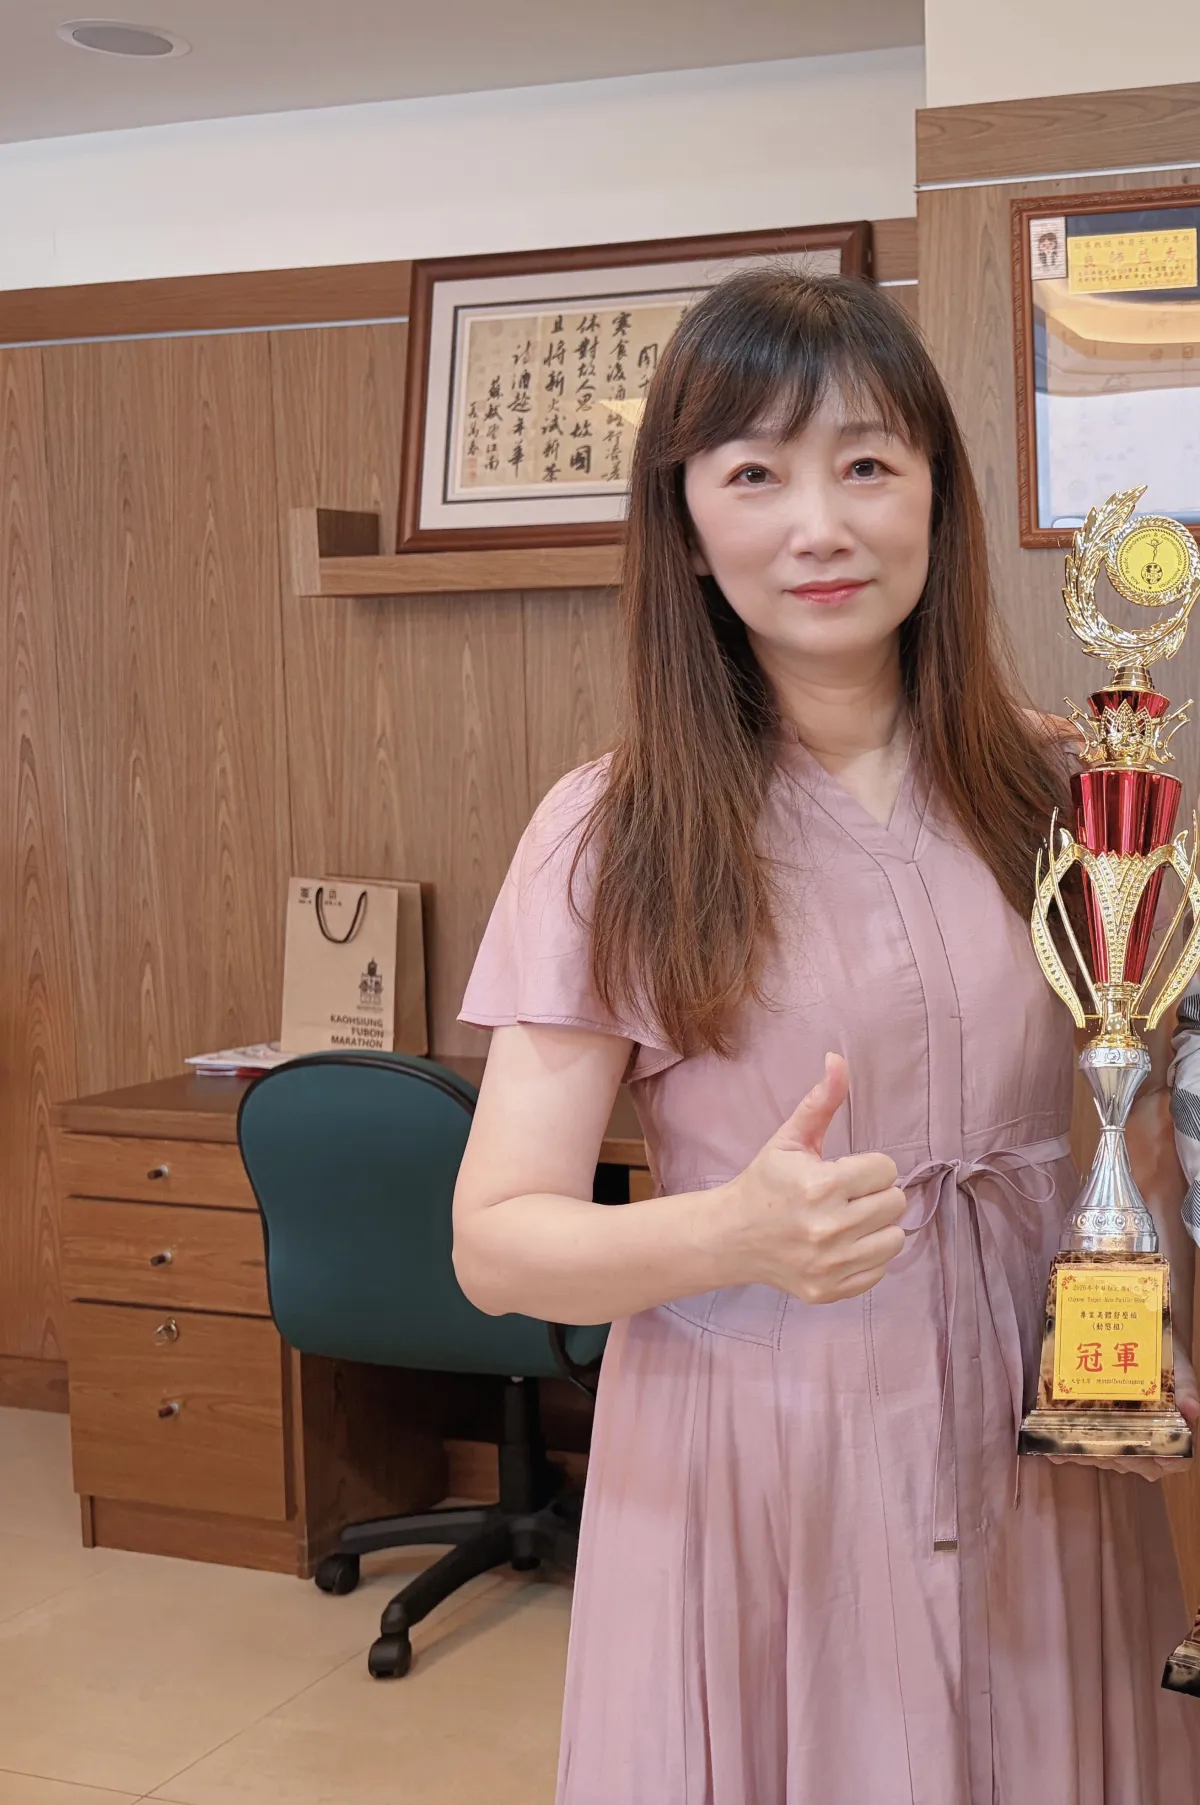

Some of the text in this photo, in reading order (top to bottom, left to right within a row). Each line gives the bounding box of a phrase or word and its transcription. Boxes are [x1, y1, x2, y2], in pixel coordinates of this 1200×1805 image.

[331, 1015, 383, 1028] KAOHSIUNG
[352, 1027, 384, 1038] FUBON
[331, 1035, 383, 1048] MARATHON
[1076, 1342, 1139, 1374] 冠軍
